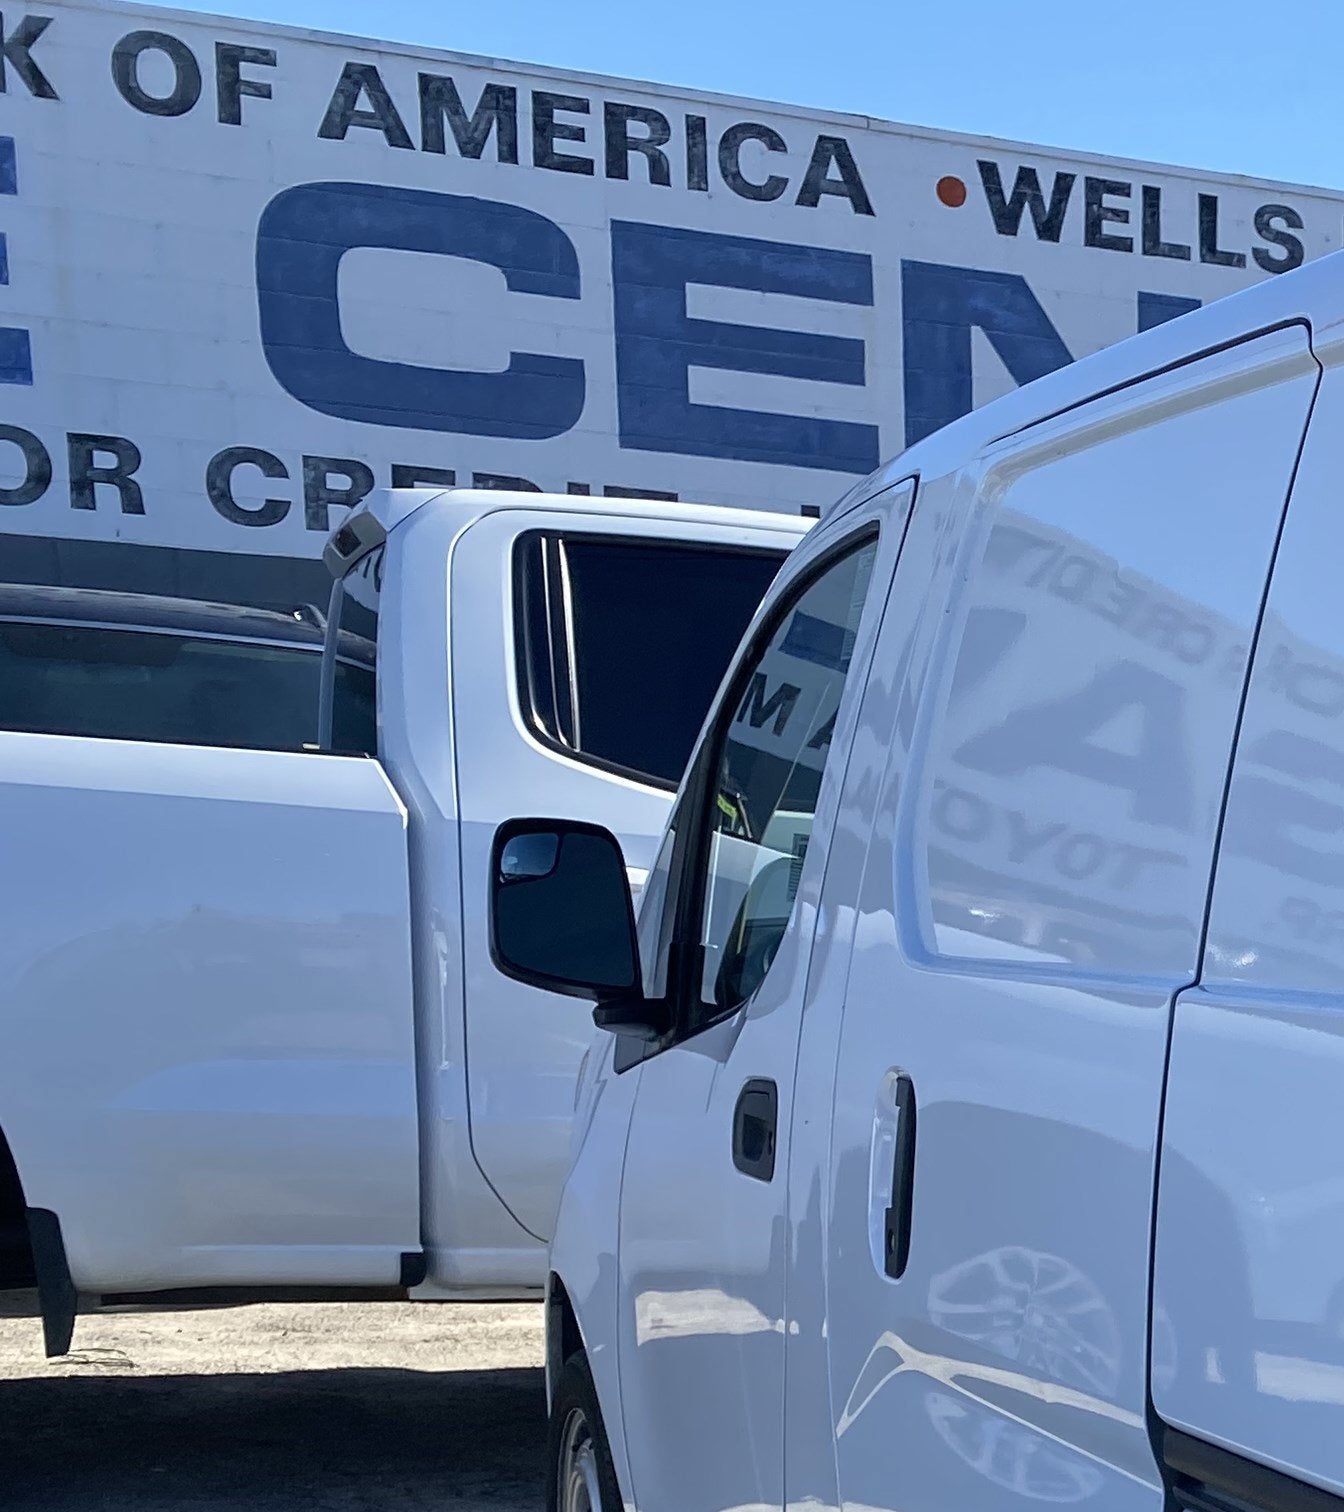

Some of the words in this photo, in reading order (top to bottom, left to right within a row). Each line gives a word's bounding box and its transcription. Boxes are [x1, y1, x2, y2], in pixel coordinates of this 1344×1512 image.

[110, 29, 277, 126] OF
[317, 61, 876, 217] AMERICA
[976, 159, 1306, 274] WELLS
